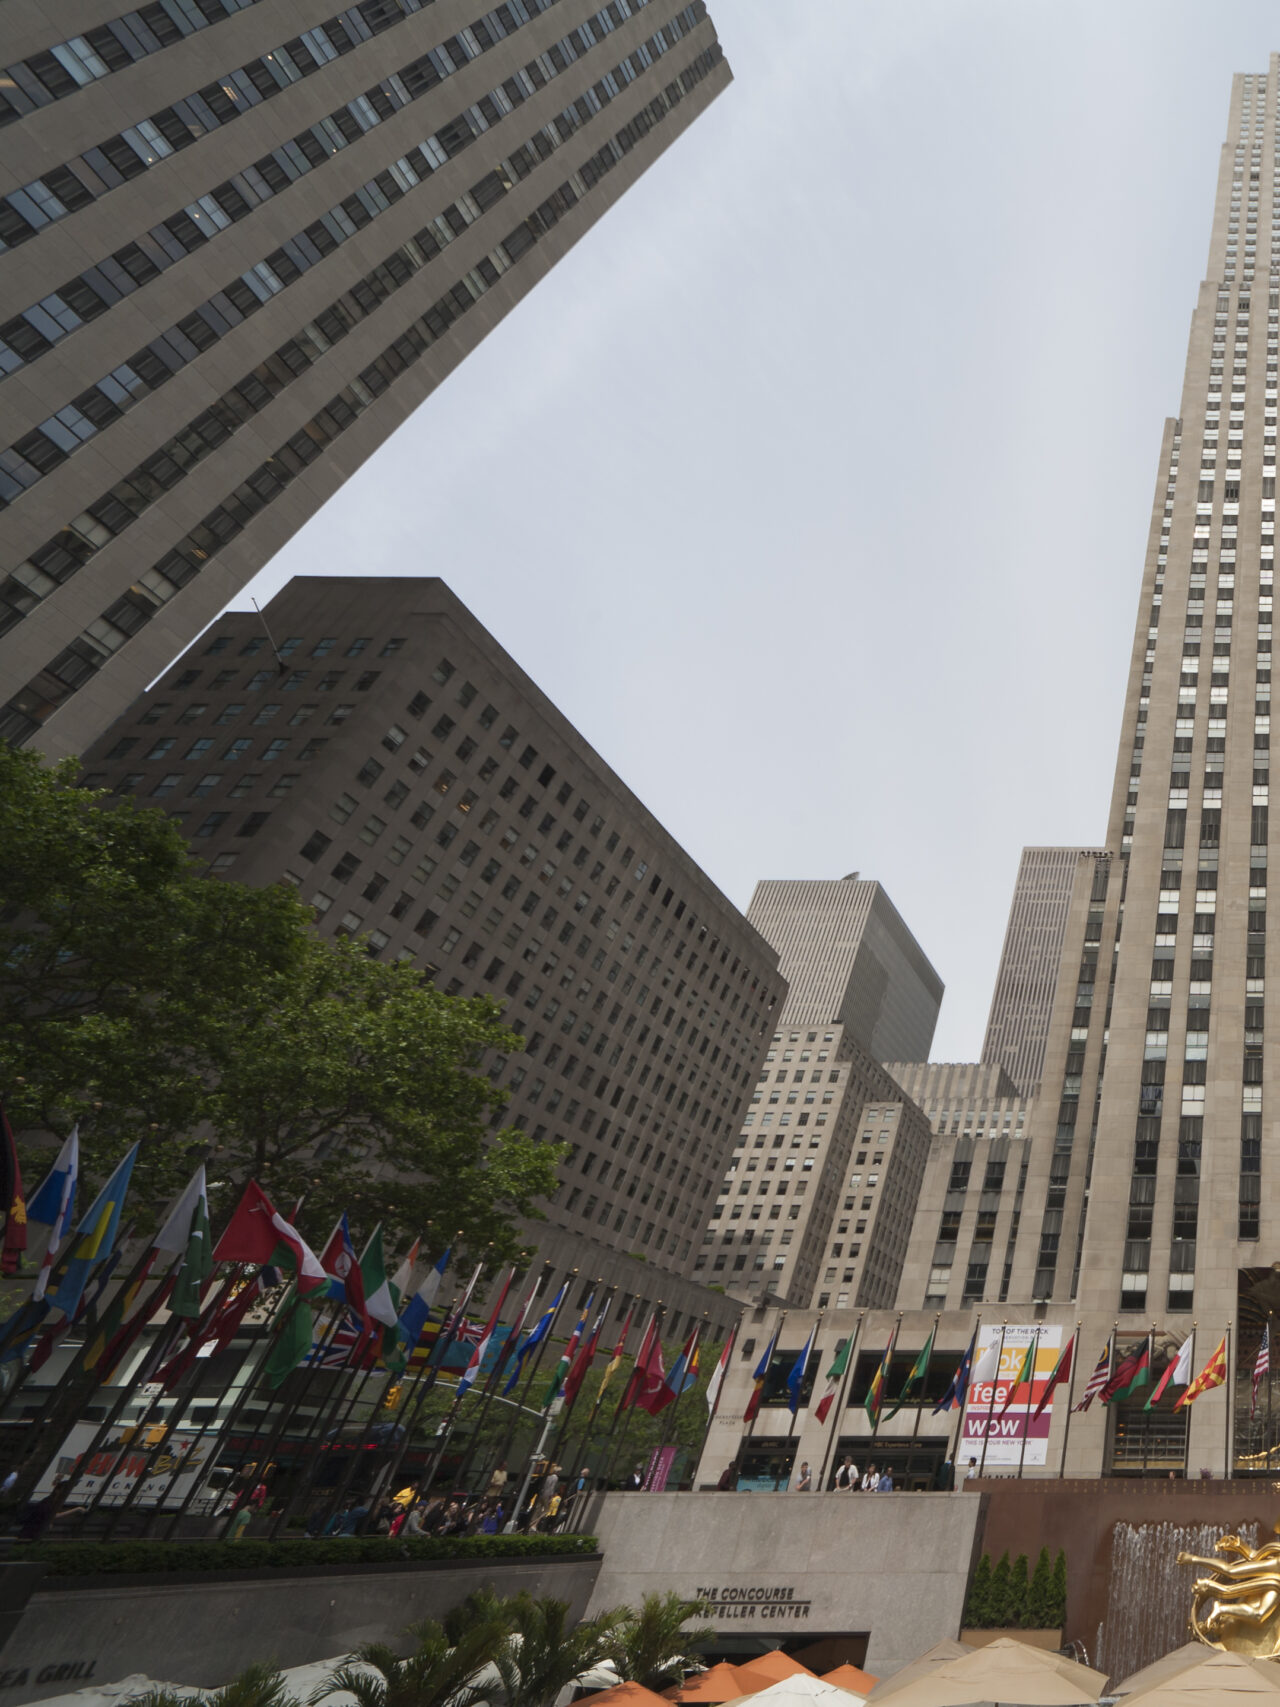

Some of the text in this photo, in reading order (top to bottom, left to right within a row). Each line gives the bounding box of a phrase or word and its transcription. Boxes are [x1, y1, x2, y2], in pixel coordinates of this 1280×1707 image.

[696, 1587, 795, 1601] THE CONCOURSE
[760, 1605, 811, 1619] CENTER
[0, 1660, 97, 1690] EA GRILL
